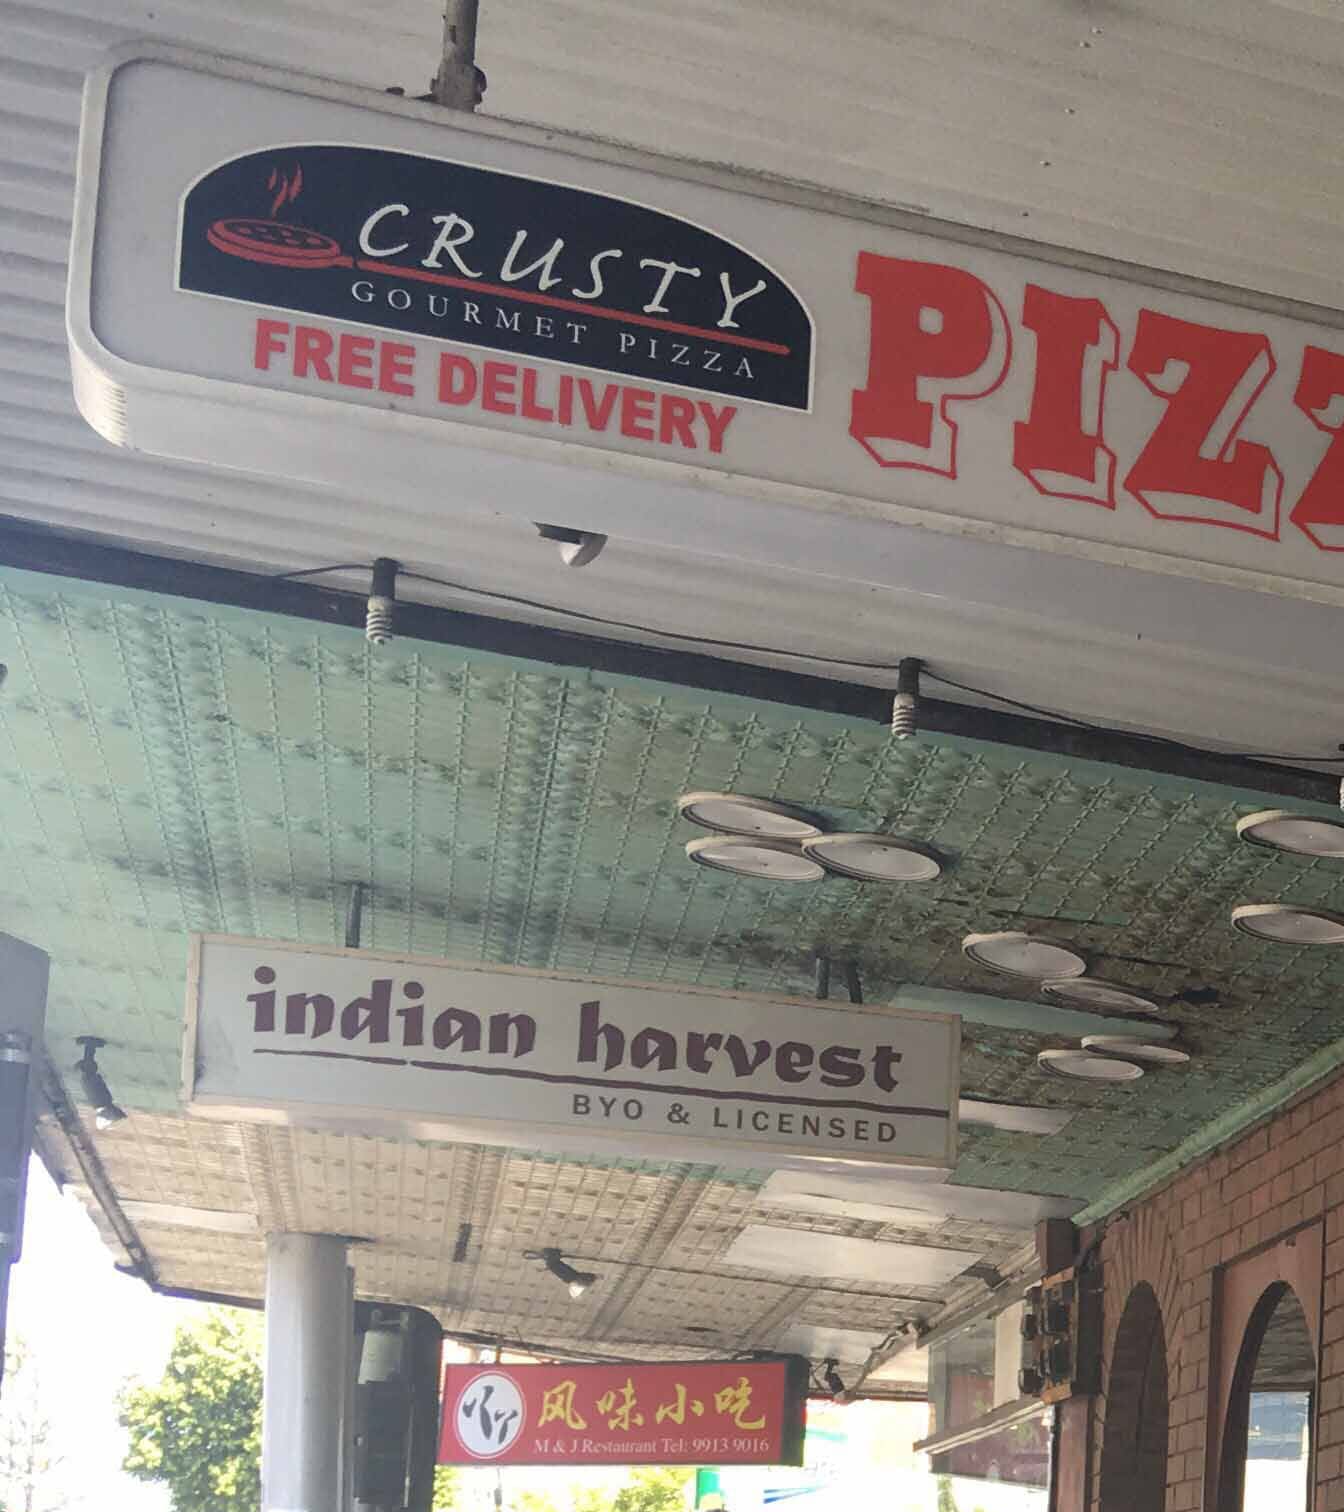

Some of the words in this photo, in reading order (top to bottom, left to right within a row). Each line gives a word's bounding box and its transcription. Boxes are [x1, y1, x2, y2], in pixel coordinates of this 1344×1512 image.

[357, 202, 768, 332] CRUSTY
[350, 280, 588, 345] GOURMET
[618, 330, 756, 380] PIZZA
[252, 317, 417, 398] FREE
[437, 351, 738, 454] DELIVERY
[246, 965, 537, 1057] indian
[577, 1000, 904, 1094] harvest
[572, 1093, 645, 1120] BYO
[666, 1102, 692, 1125] &
[713, 1106, 898, 1144] LICENSED
[534, 1439, 548, 1454] M
[583, 1438, 657, 1455] Restaurant
[537, 1376, 766, 1431] 风味小吃
